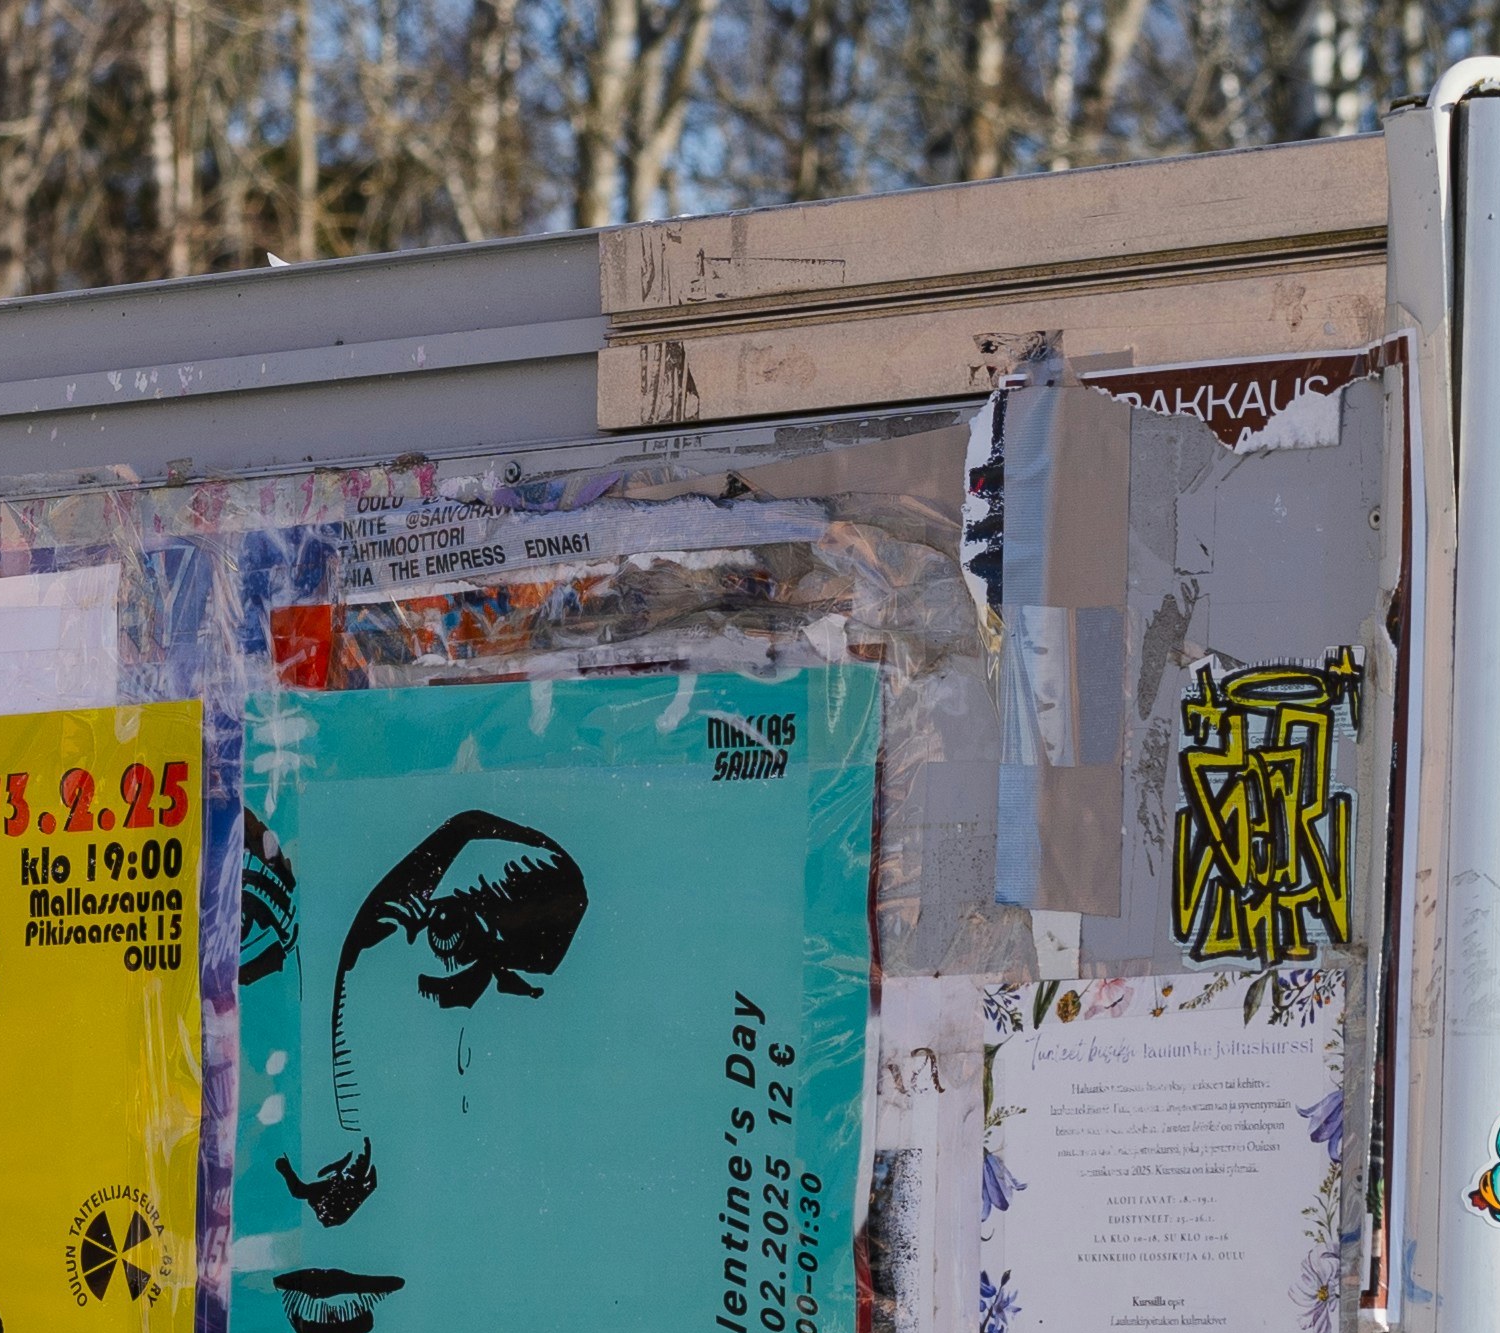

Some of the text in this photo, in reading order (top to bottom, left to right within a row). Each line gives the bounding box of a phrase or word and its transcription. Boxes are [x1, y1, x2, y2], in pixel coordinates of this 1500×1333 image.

[389, 533, 591, 582] THE EMPRESS EDNA61
[21, 838, 183, 886] klo 19:00
[29, 887, 183, 918] Mallassauna
[25, 914, 182, 947] Pikisaarent 15
[123, 943, 182, 972] OULU
[725, 991, 768, 1090] Day
[768, 1085, 795, 1130] 12
